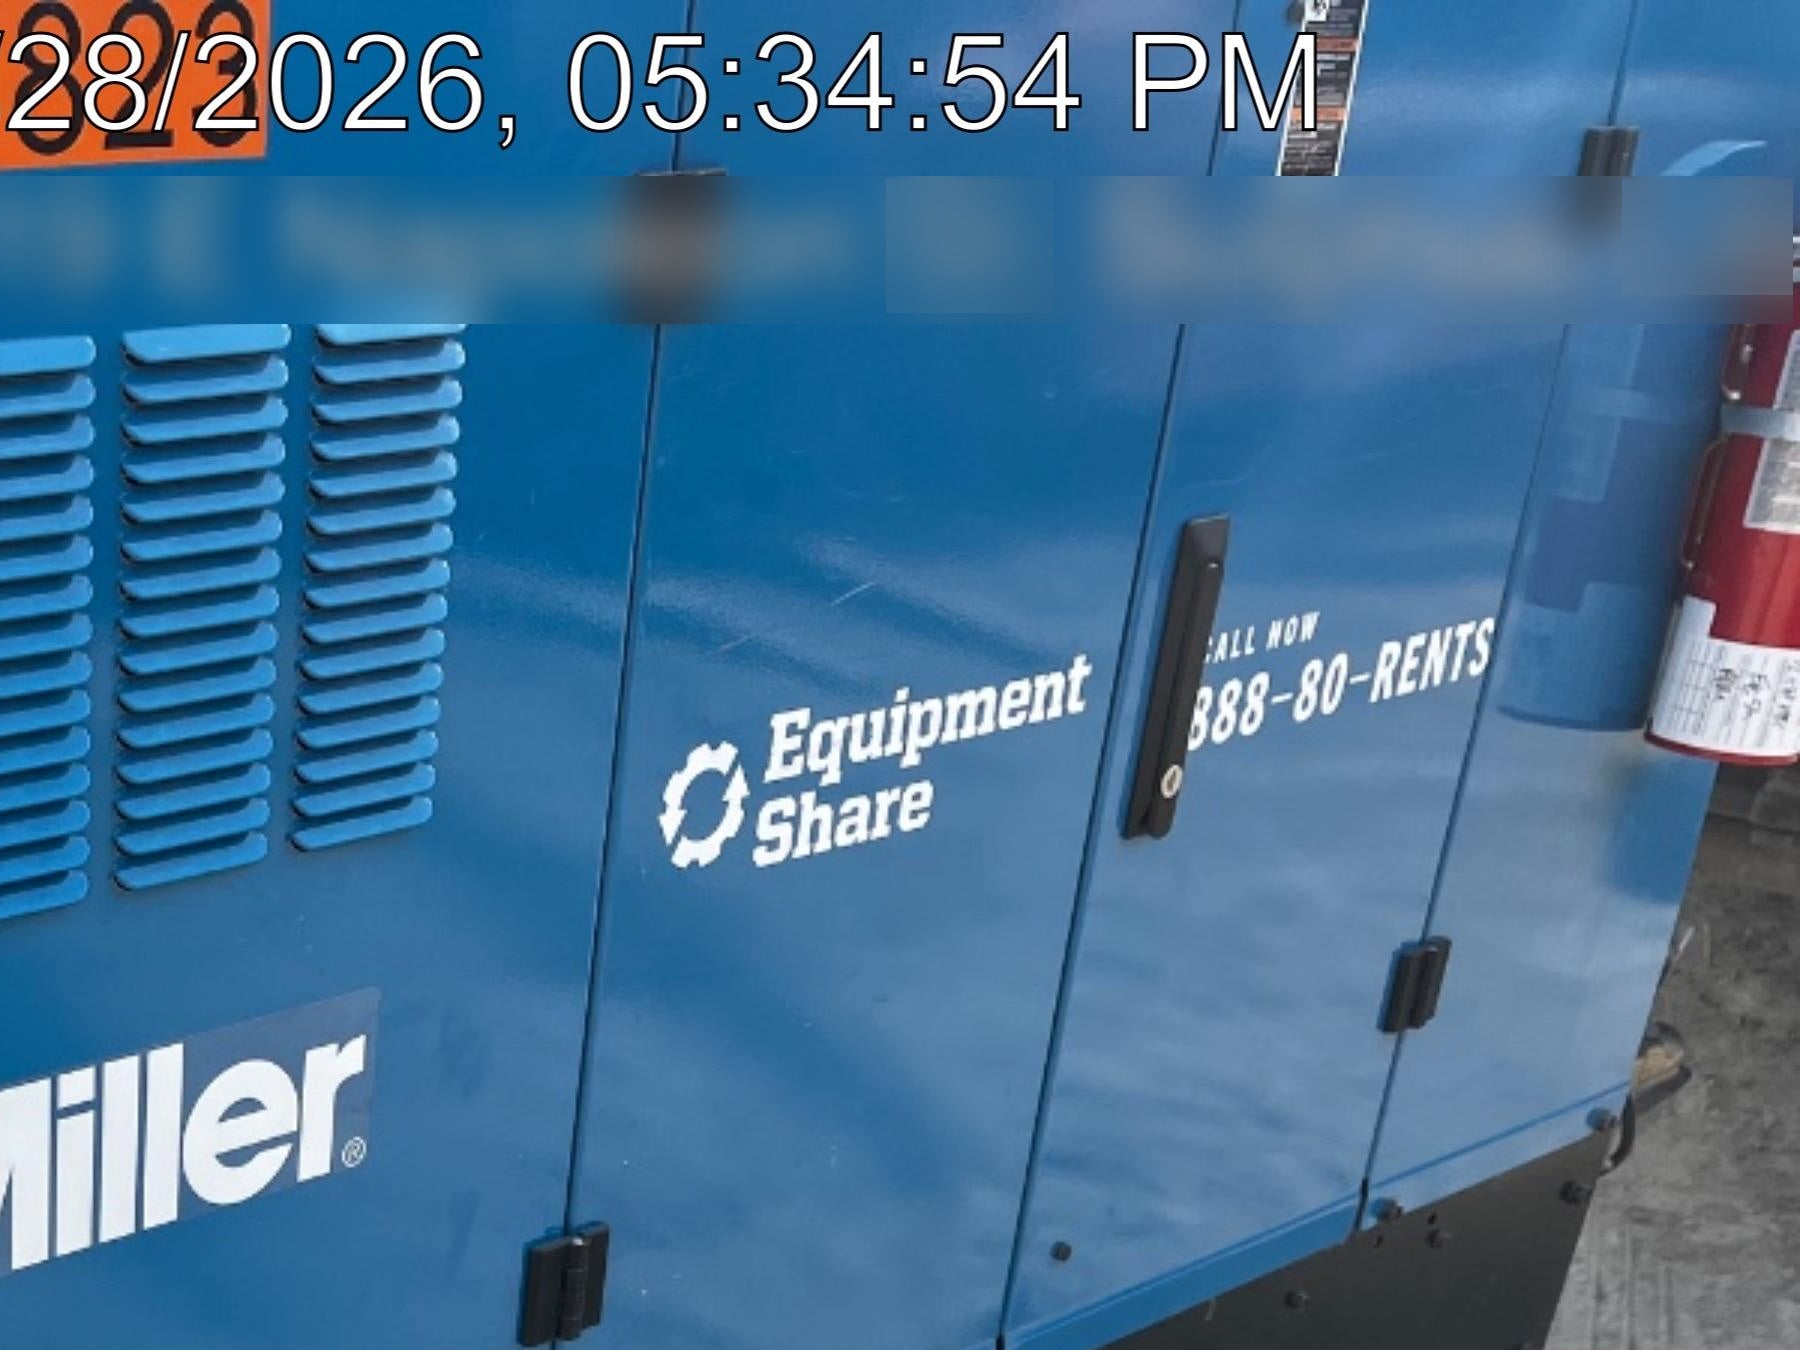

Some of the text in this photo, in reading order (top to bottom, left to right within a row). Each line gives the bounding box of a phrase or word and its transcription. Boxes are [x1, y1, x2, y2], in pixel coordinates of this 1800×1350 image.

[1265, 611, 1321, 650] NOW
[762, 652, 1093, 787] Equipment
[752, 777, 935, 868] Share
